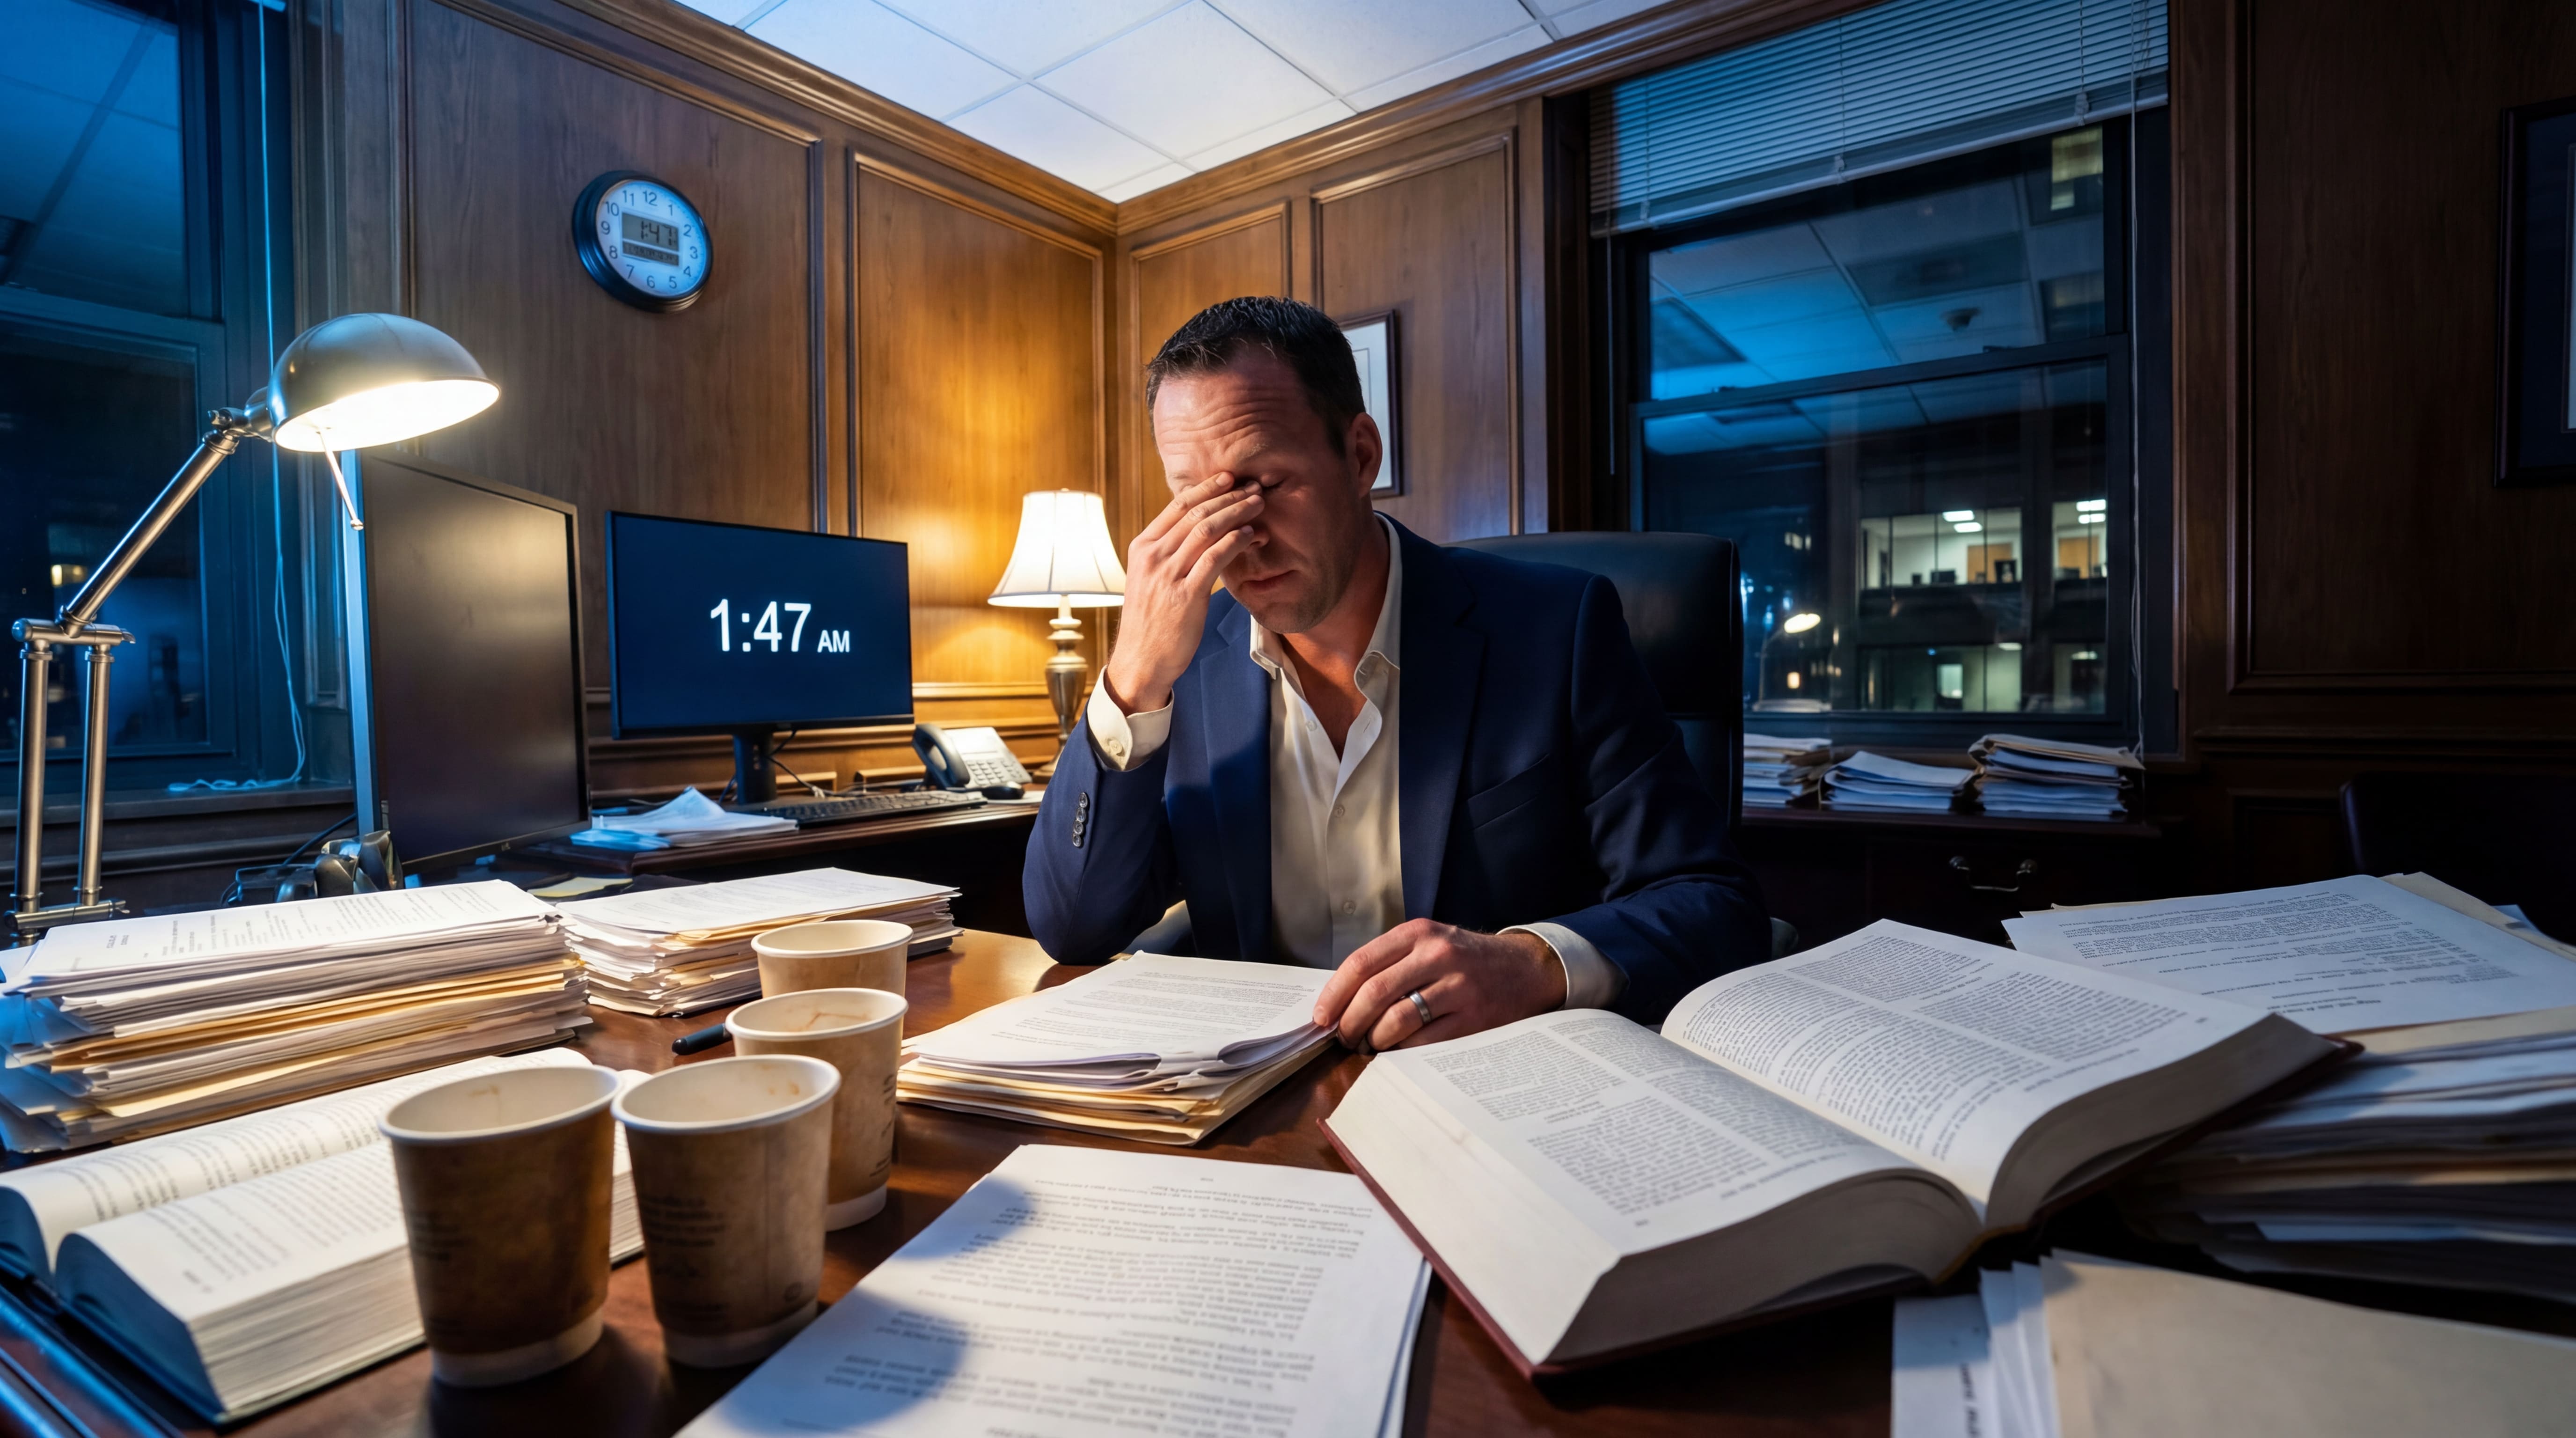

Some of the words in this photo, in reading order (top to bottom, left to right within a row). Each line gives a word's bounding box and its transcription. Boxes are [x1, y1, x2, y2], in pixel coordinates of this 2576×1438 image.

[622, 190, 635, 206] 11
[643, 190, 658, 206] 12
[605, 201, 620, 216] 10
[668, 204, 673, 216] 1
[600, 220, 611, 235] 9
[640, 220, 673, 246] 1:47
[683, 224, 692, 237] 2
[609, 245, 618, 259] 8
[689, 246, 698, 259] 3
[626, 264, 635, 279] 7
[683, 266, 691, 278] 4
[646, 275, 655, 288] 6
[669, 276, 678, 289] 5
[710, 599, 812, 652] 1:47
[817, 630, 850, 653] AM
